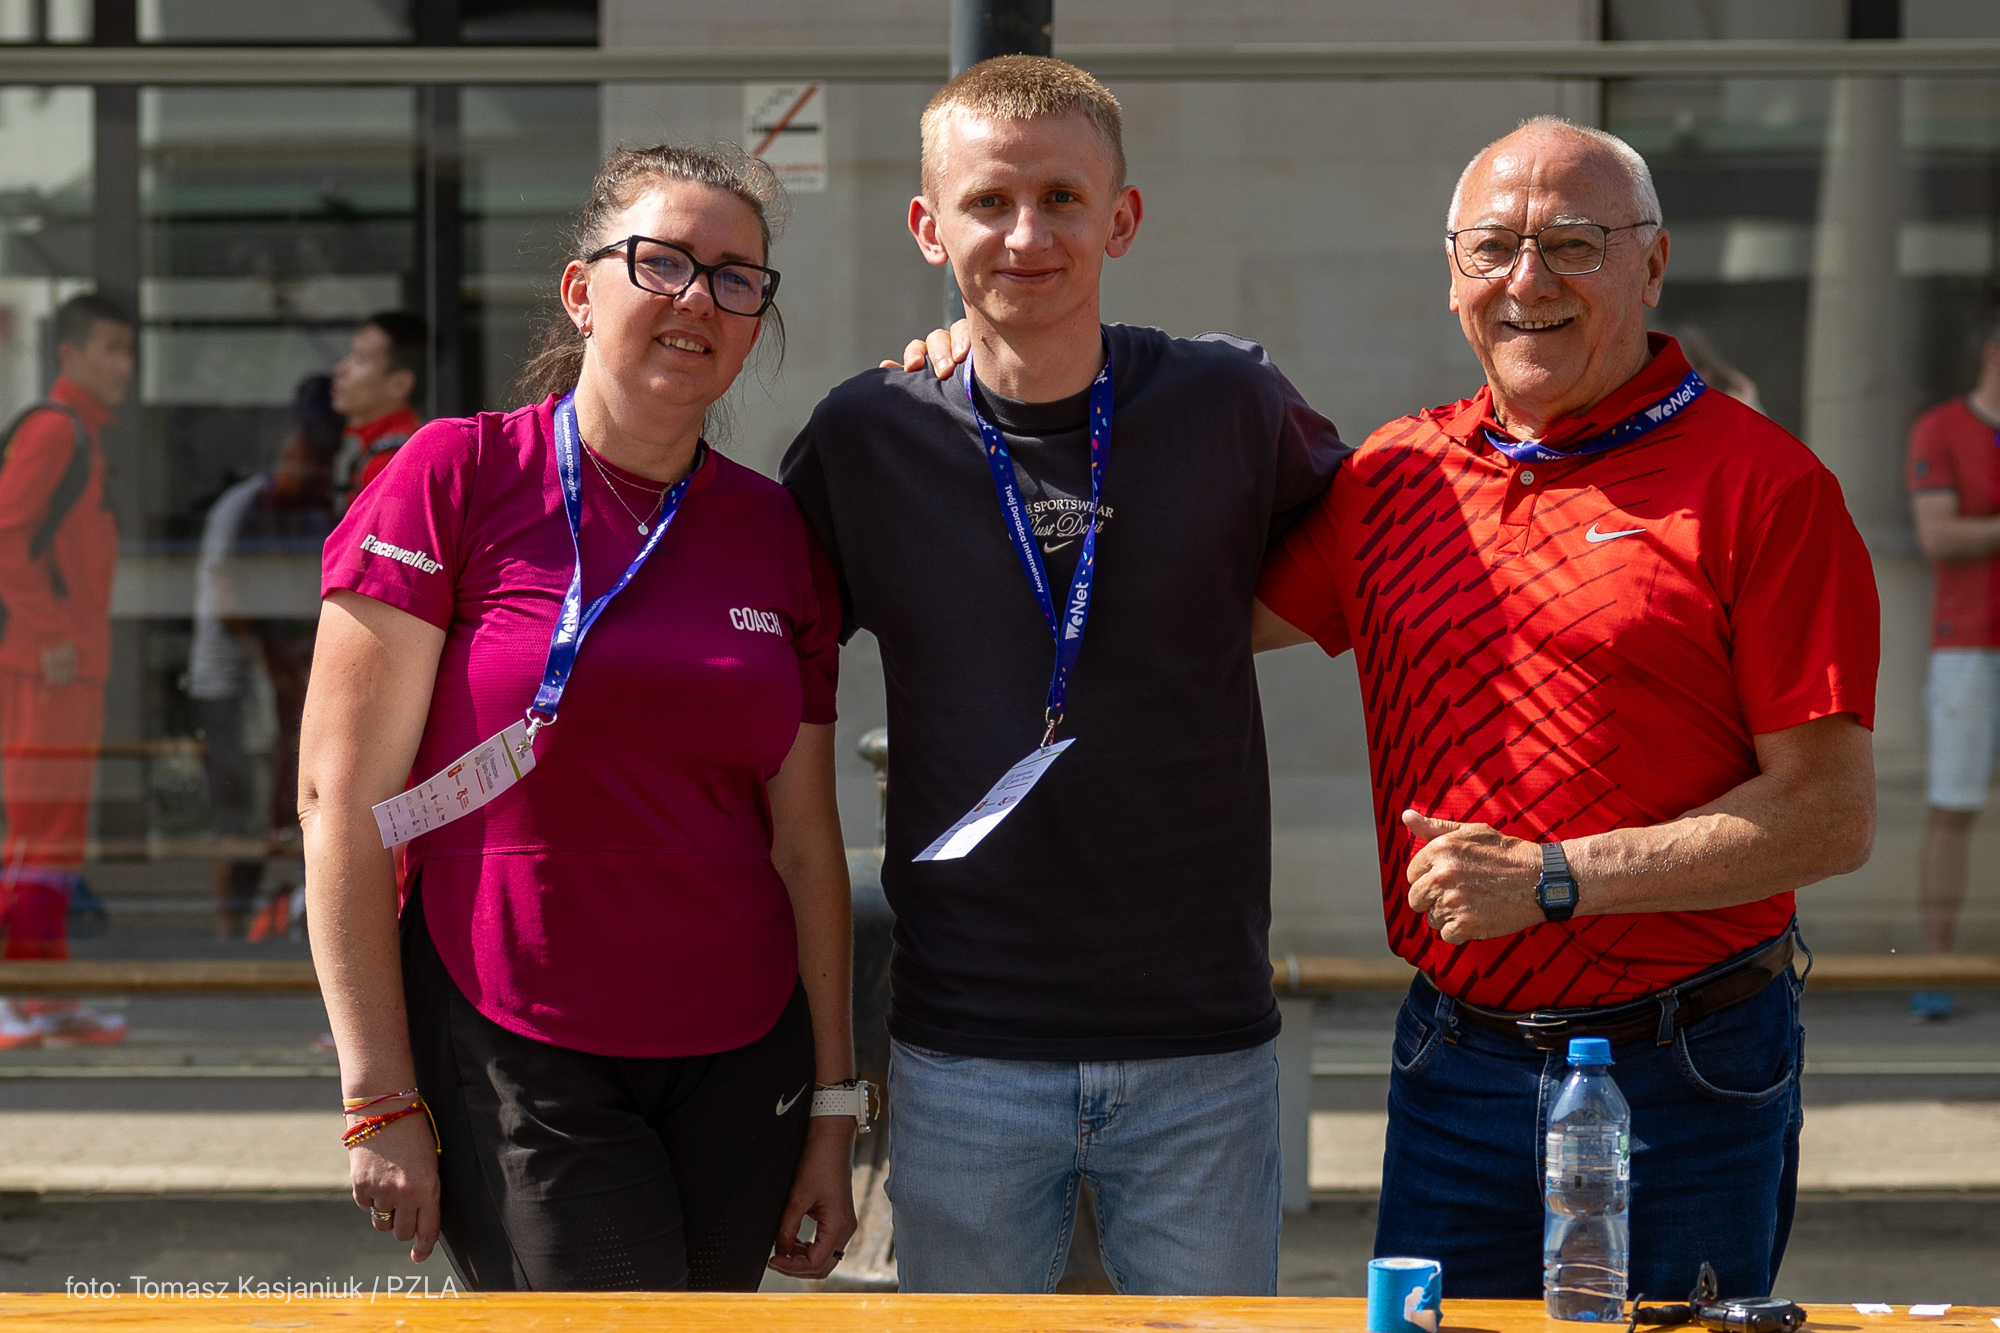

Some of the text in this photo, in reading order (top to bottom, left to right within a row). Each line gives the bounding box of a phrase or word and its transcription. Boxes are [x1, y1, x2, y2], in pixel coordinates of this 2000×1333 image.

[1644, 383, 1696, 423] WeNet
[1004, 484, 1045, 593] Twój Doradca Internetowy
[1056, 511, 1091, 538] Do
[359, 533, 444, 575] Racewalker
[556, 595, 579, 644] WeNet
[729, 606, 783, 637] COACH
[1064, 581, 1089, 640] WeNet
